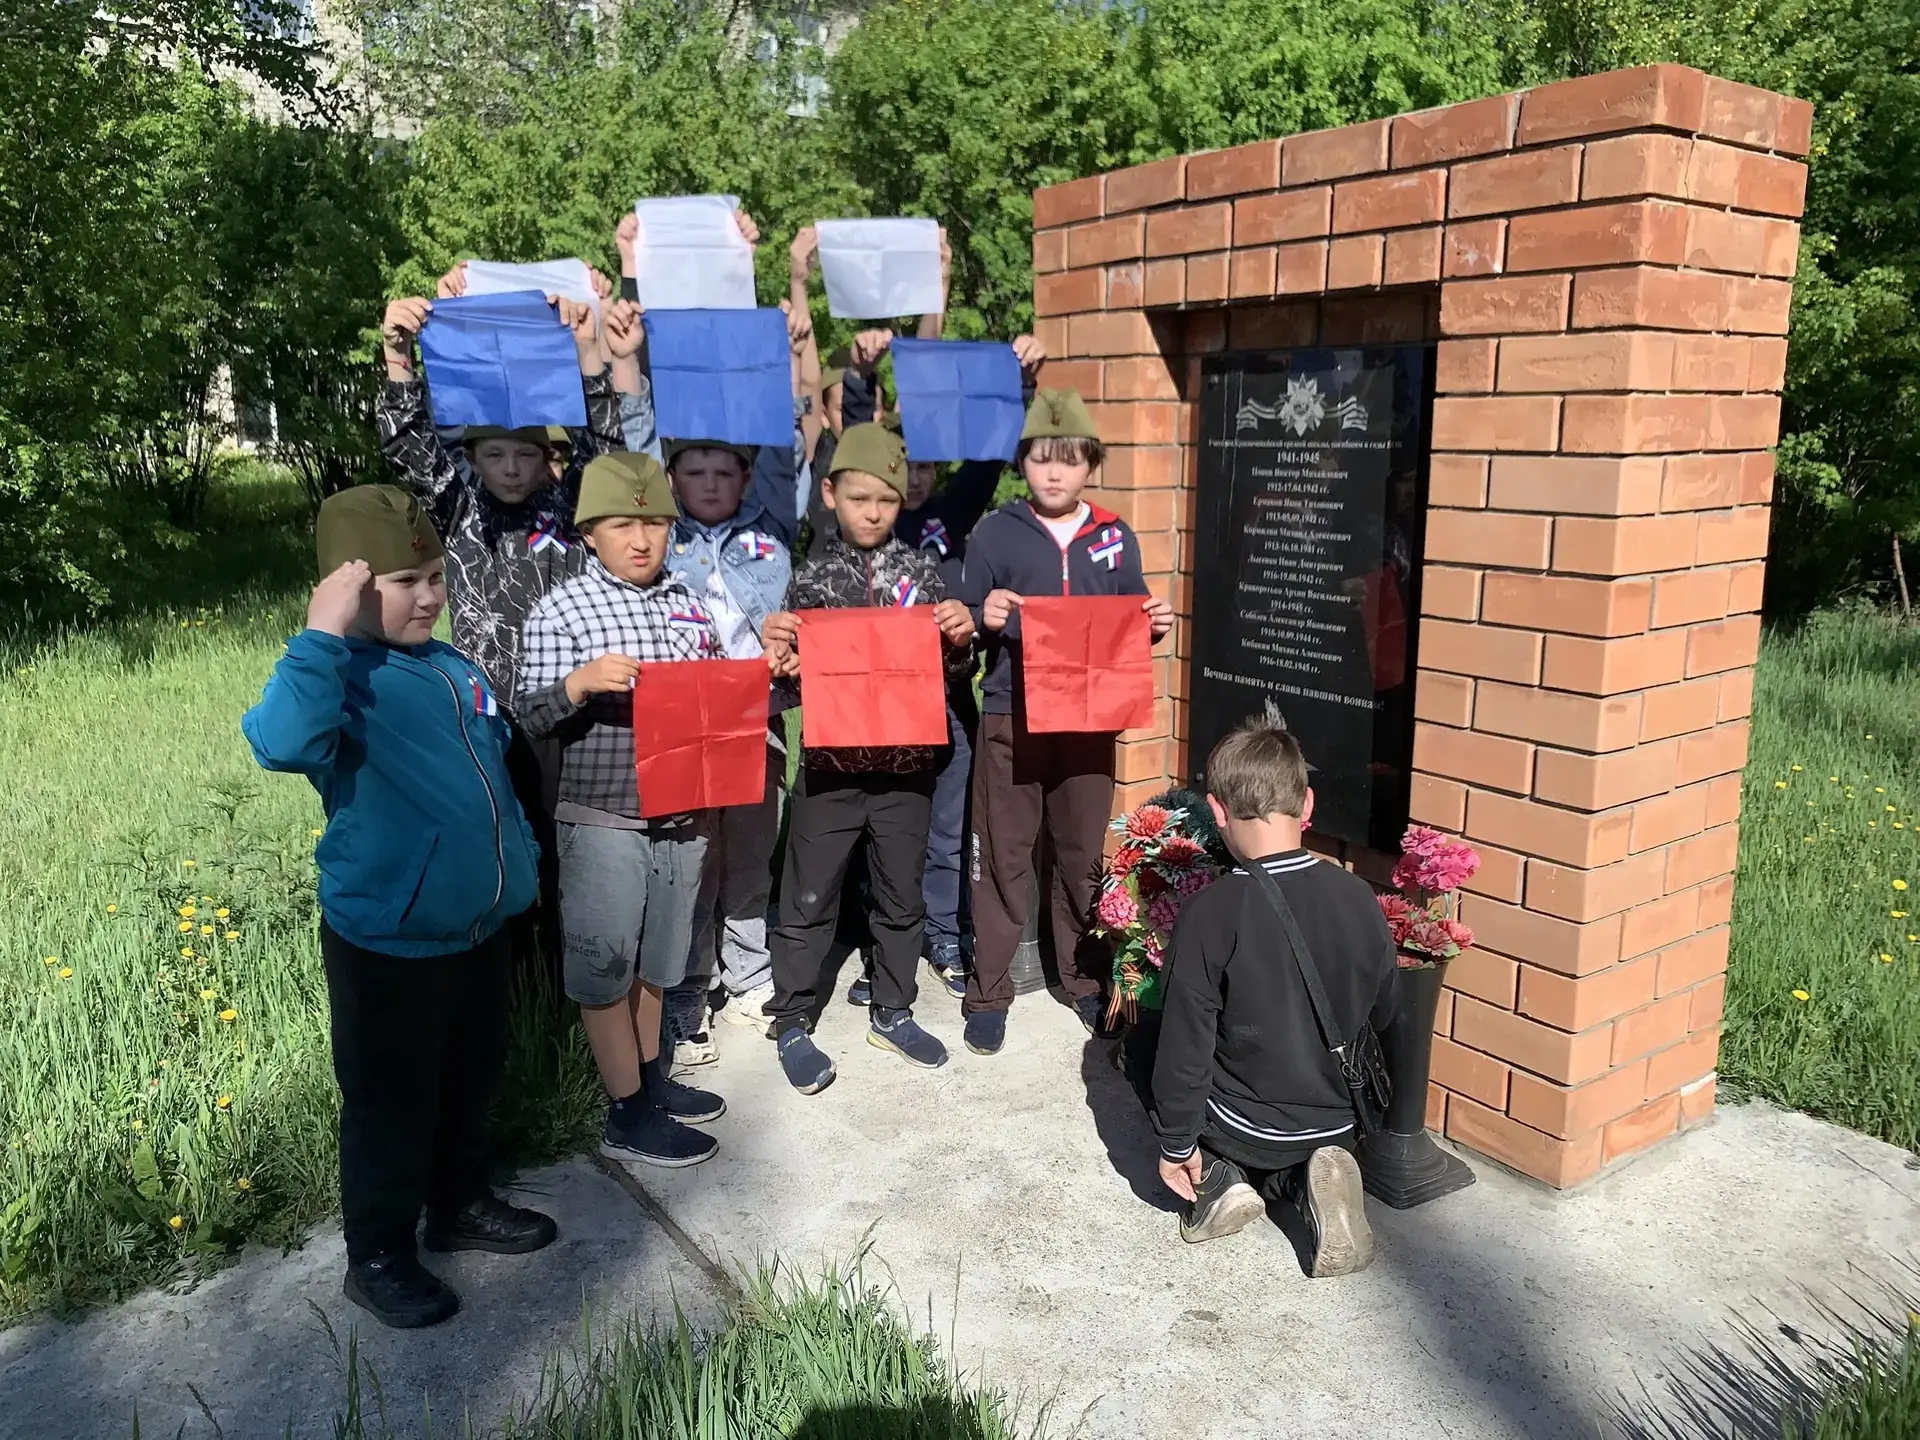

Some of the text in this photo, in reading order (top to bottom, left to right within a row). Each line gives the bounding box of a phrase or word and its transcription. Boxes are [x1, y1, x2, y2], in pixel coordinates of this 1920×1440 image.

[1277, 450, 1320, 463] 1941-1945
[1274, 467, 1300, 478] Виктор
[1301, 467, 1348, 479] Михайлович
[1319, 486, 1329, 494] гг.
[1283, 497, 1301, 507] Яков
[1304, 498, 1344, 510] Тихонович
[1318, 517, 1328, 525] гг.
[1280, 526, 1307, 537] Михаил
[1309, 530, 1352, 541] Алексеевич
[1317, 547, 1327, 555] гг.
[1278, 556, 1296, 567] Иван
[1297, 558, 1344, 572] Дмитриевич
[1307, 588, 1351, 603] Васильевич
[1304, 605, 1314, 614] гг.
[1268, 614, 1305, 628] Александр
[1306, 619, 1347, 633] Яковлевич
[1312, 636, 1322, 645] гг.
[1272, 643, 1298, 655] Михаил
[1299, 648, 1343, 663] Алексеевич
[1311, 666, 1320, 674] гг.
[1203, 667, 1233, 682] Вечная
[1234, 672, 1266, 688] память
[1267, 680, 1273, 690] и
[1275, 683, 1302, 695] слава
[1302, 687, 1342, 703] павшим
[564, 944, 600, 958] ystem
